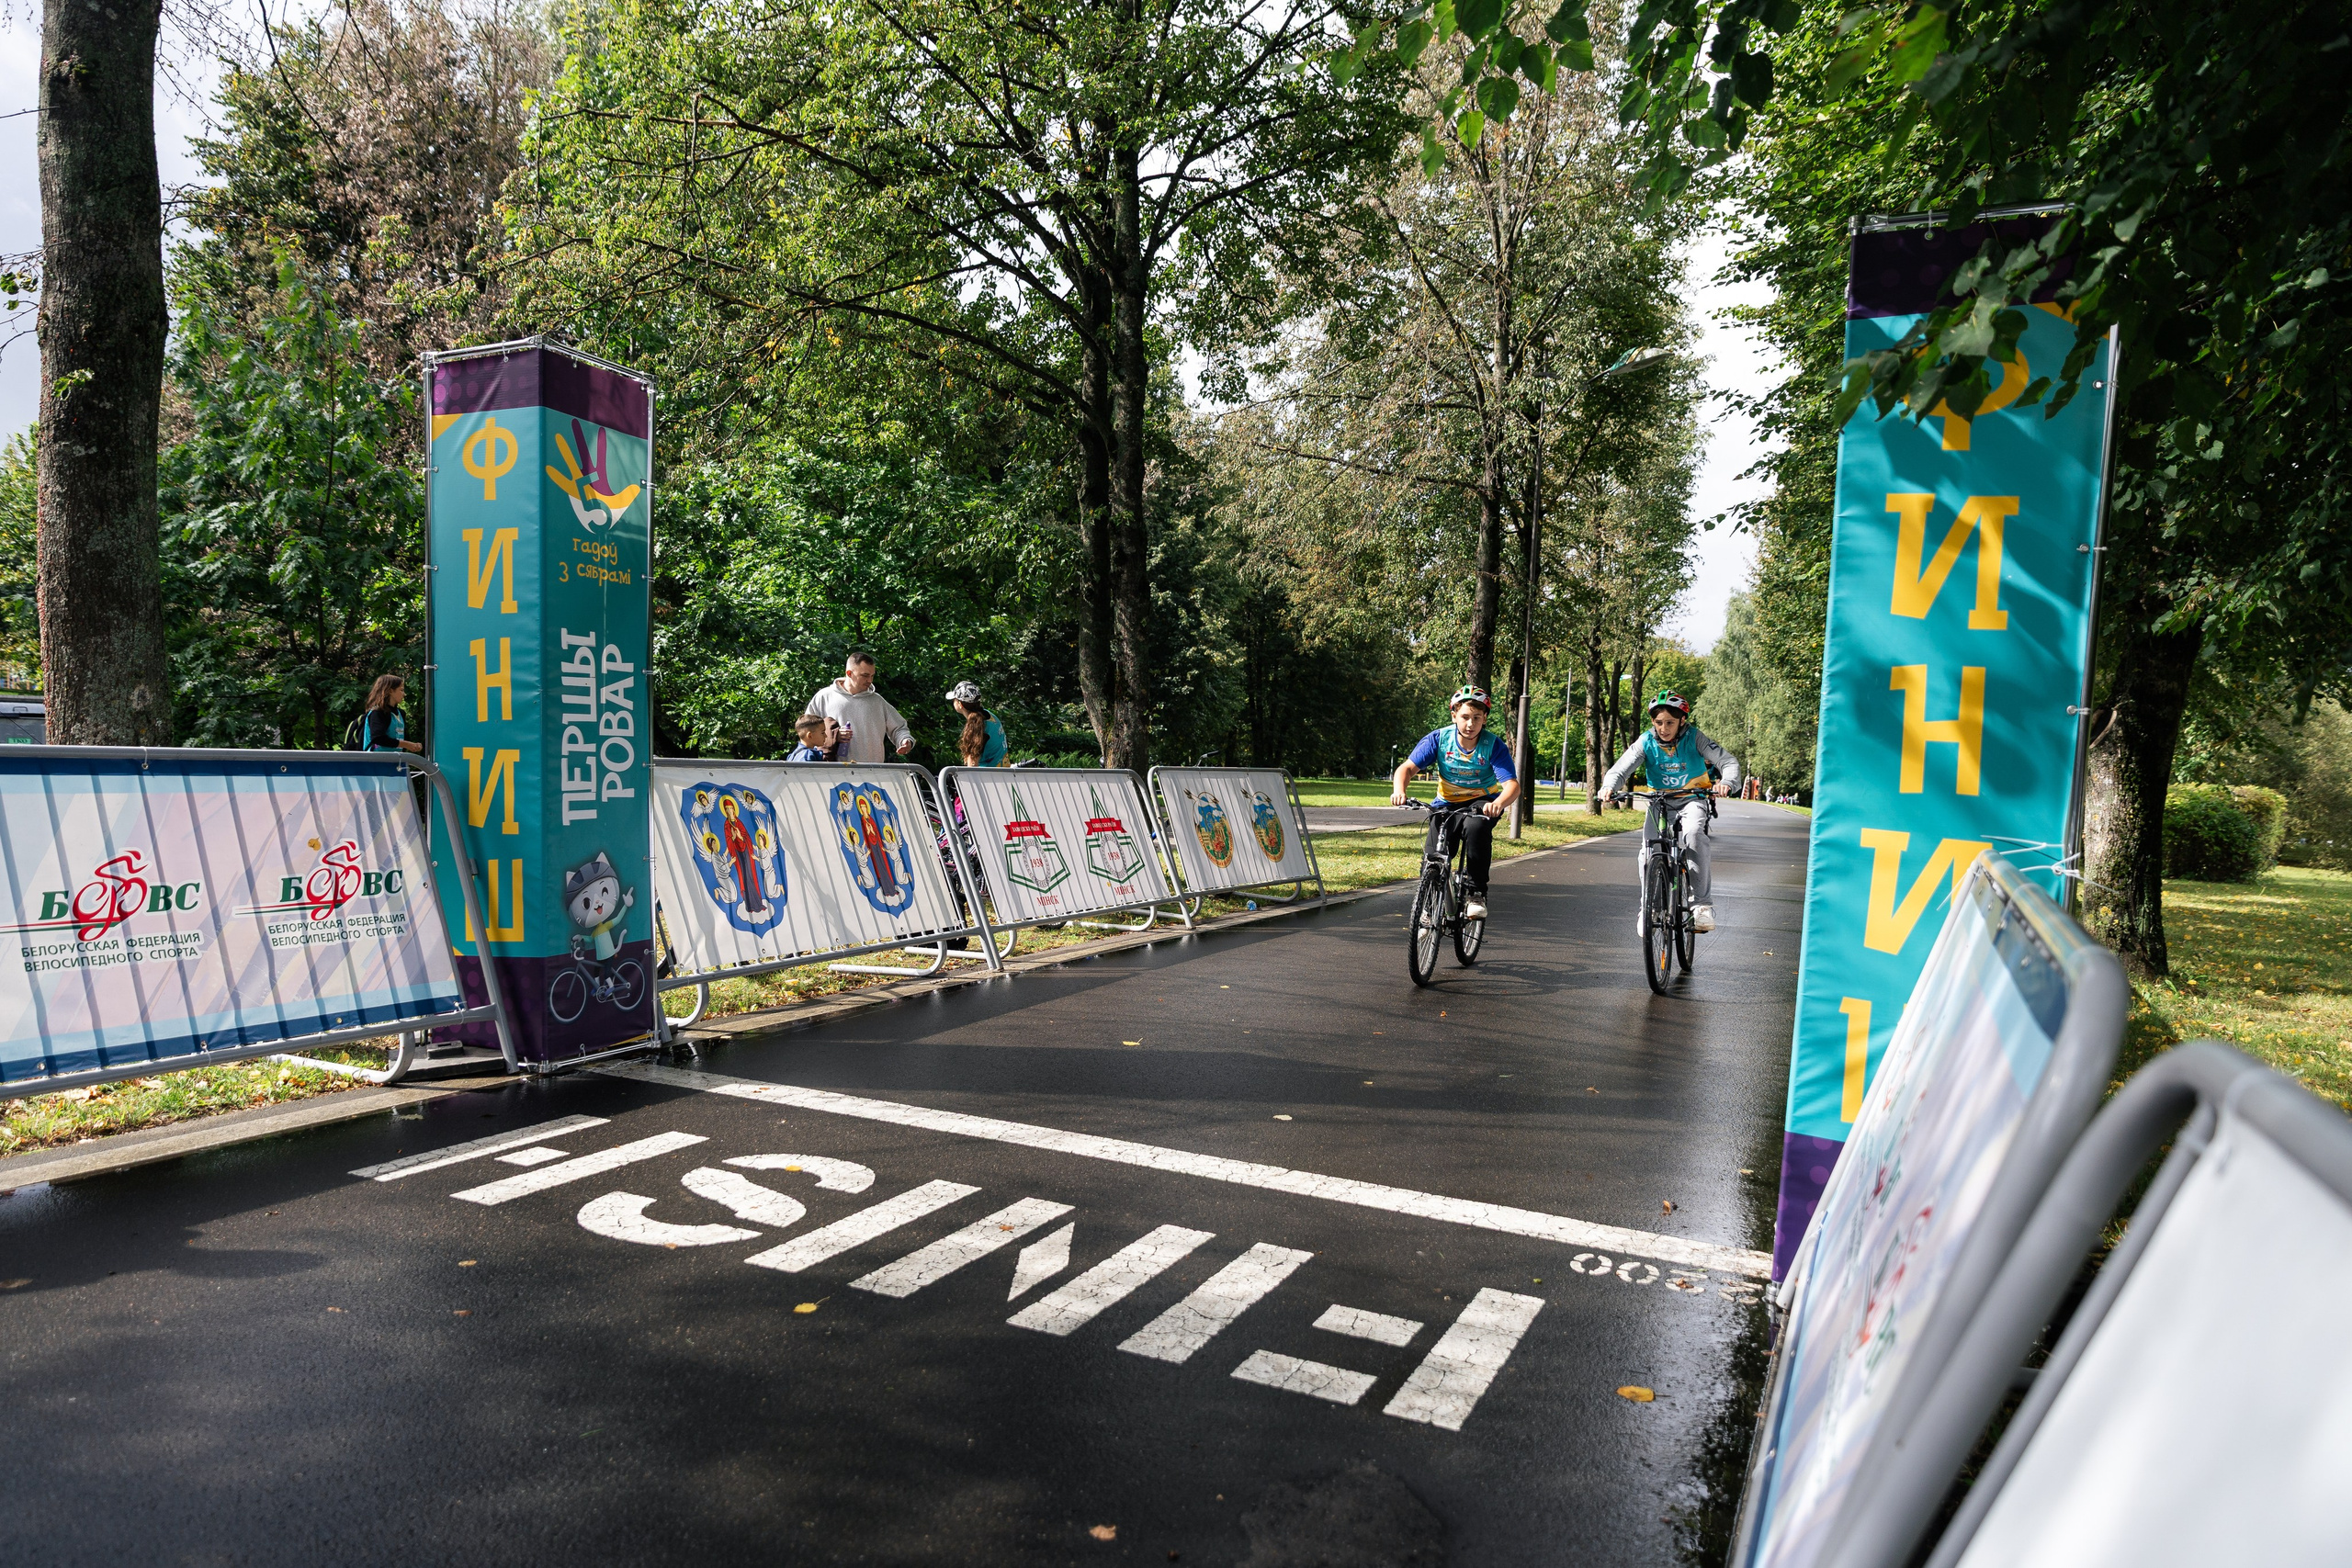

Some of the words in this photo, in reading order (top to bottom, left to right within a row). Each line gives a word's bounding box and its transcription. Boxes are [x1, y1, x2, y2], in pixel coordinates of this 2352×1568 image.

[576, 562, 632, 587] сябрамі
[462, 417, 525, 942] ФИНИШ
[560, 627, 596, 827] ПЕРШЫ
[600, 643, 635, 803] РОВАР
[1661, 773, 1689, 787] 397
[1030, 857, 1044, 869] 1938
[1107, 851, 1121, 861] 1938
[267, 919, 344, 935] БЕЛОРУССКАЯ
[347, 913, 406, 928] ФЕДЕРАЦИЯ
[271, 929, 361, 947] ВЕЛОСИПЕДНОГО
[366, 926, 405, 938] СПОРТА
[20, 939, 119, 958] БЕЛОРУССКАЯ
[126, 932, 201, 949] ФЕДЕРАЦИЯ
[24, 951, 143, 973] ВЕЛОСИПЕДНОГО
[150, 946, 198, 960] СПОРТА
[350, 1114, 1545, 1433] FINISH
